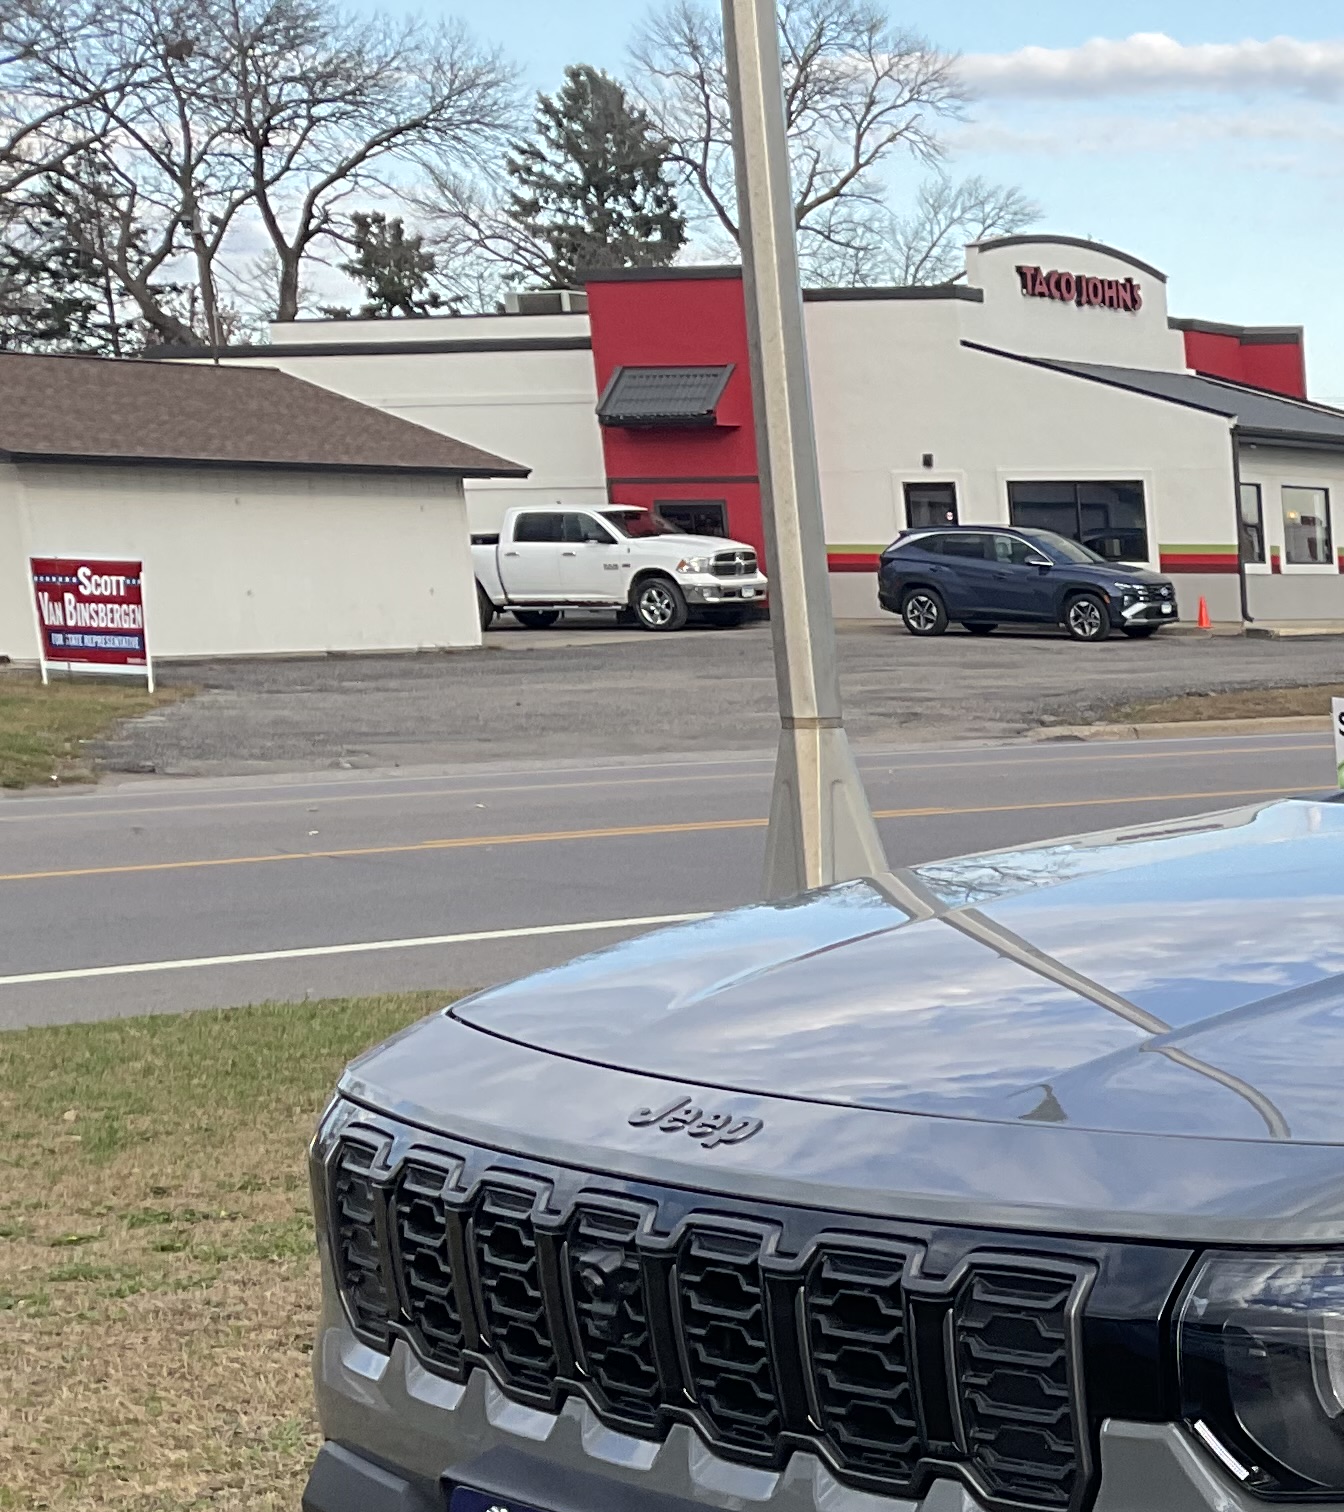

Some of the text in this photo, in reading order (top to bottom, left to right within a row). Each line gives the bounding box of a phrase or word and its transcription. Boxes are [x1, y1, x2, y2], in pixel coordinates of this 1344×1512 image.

[1017, 265, 1142, 312] TACO JOHN'S
[77, 566, 125, 596] SCOTT
[38, 592, 63, 625] VAN
[628, 1095, 764, 1149] Jeep
